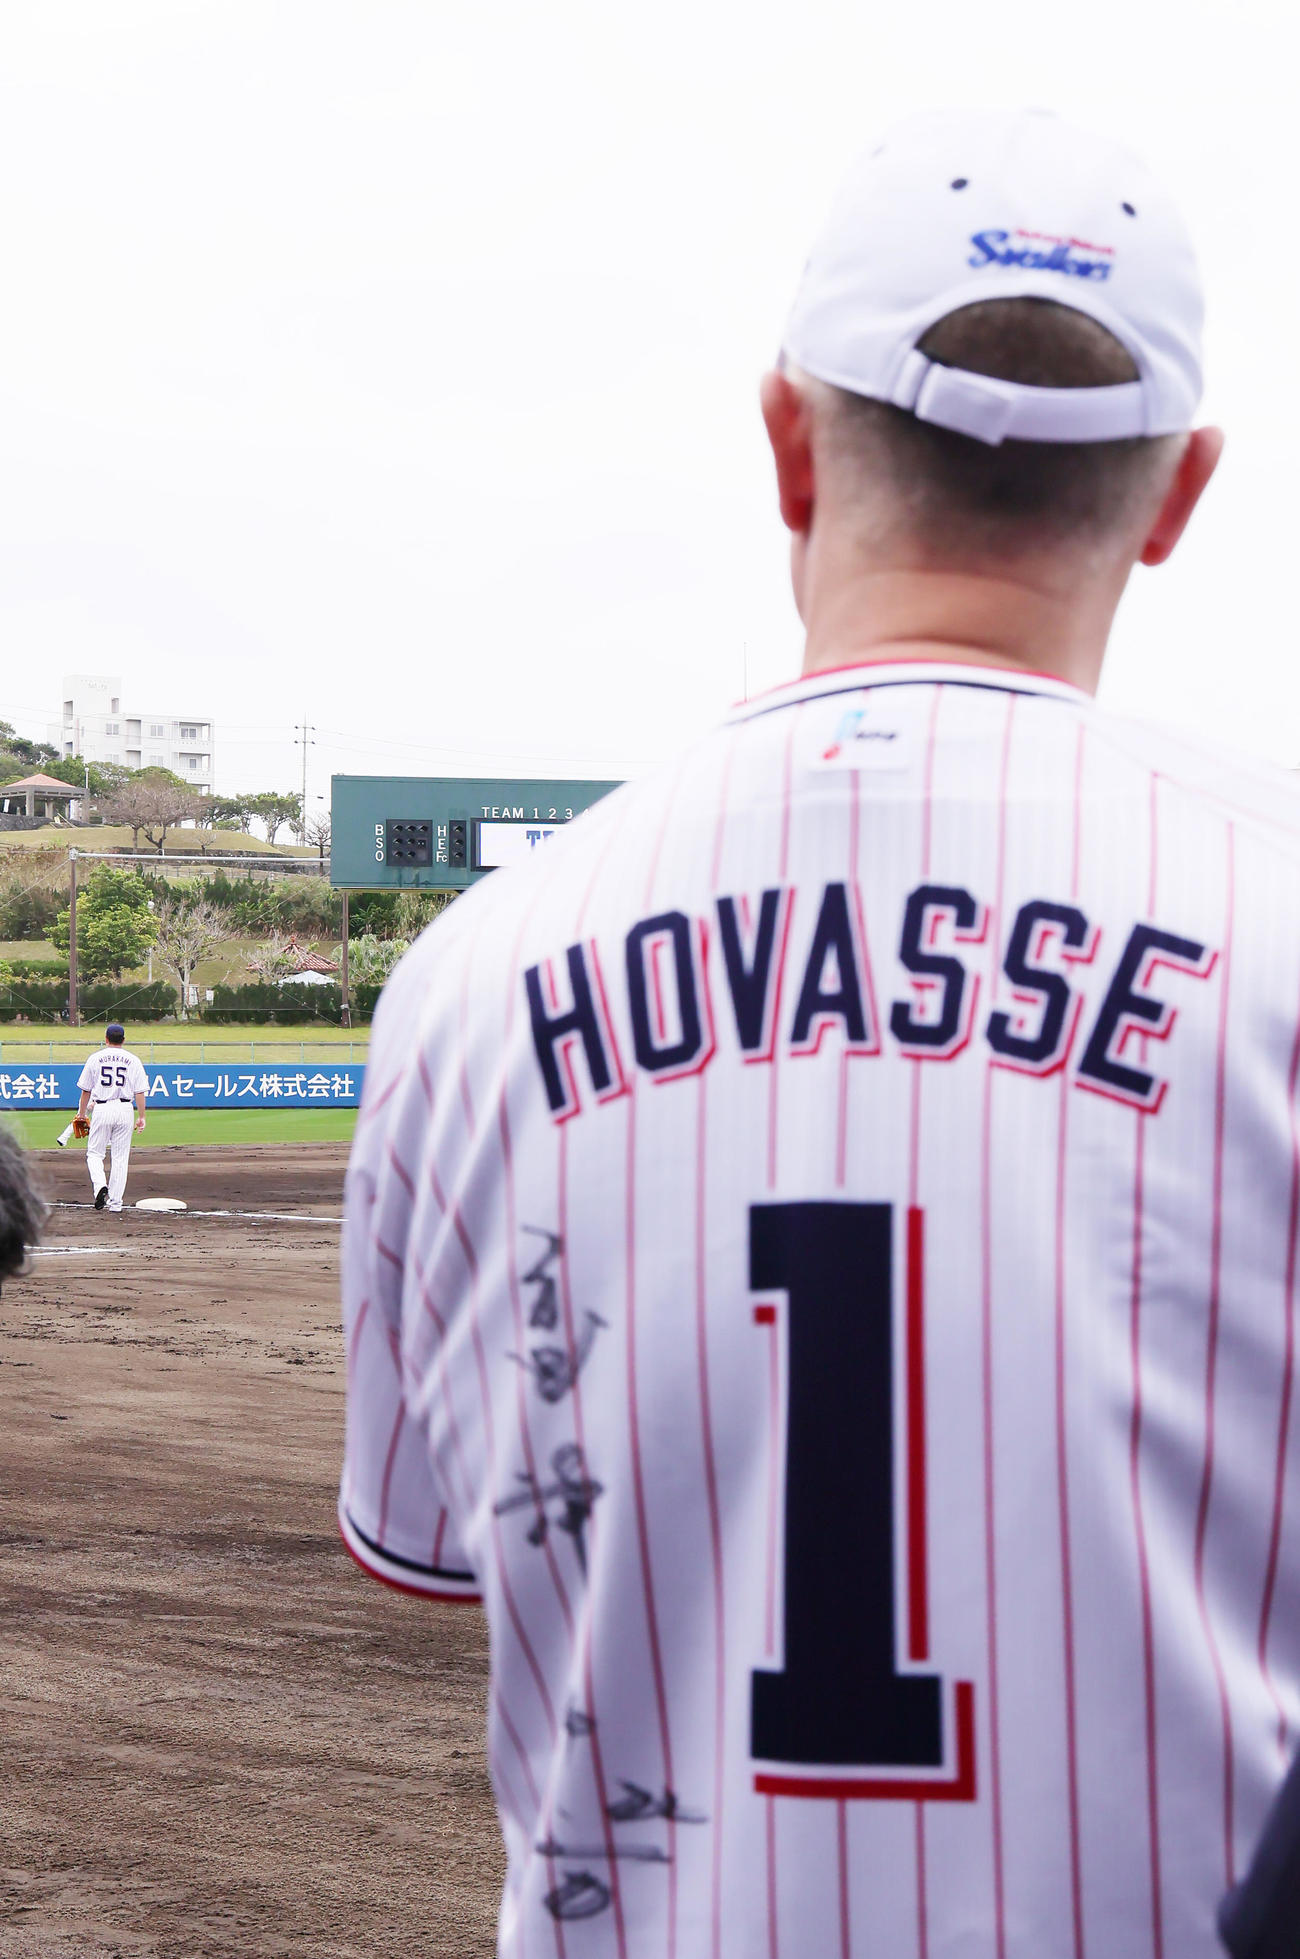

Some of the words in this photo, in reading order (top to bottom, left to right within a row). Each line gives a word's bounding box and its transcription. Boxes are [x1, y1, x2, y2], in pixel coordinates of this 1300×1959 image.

[481, 806, 524, 819] TEAM
[533, 807, 539, 818] 1
[548, 808, 557, 818] 2
[564, 808, 573, 819] 3
[375, 824, 384, 836] B
[437, 825, 447, 837] H
[375, 837, 384, 849] S
[438, 838, 447, 850] E
[436, 851, 448, 863] Fc
[523, 881, 1219, 1125] HOVASSE
[100, 1066, 127, 1087] 55
[746, 1201, 977, 1804] 1
